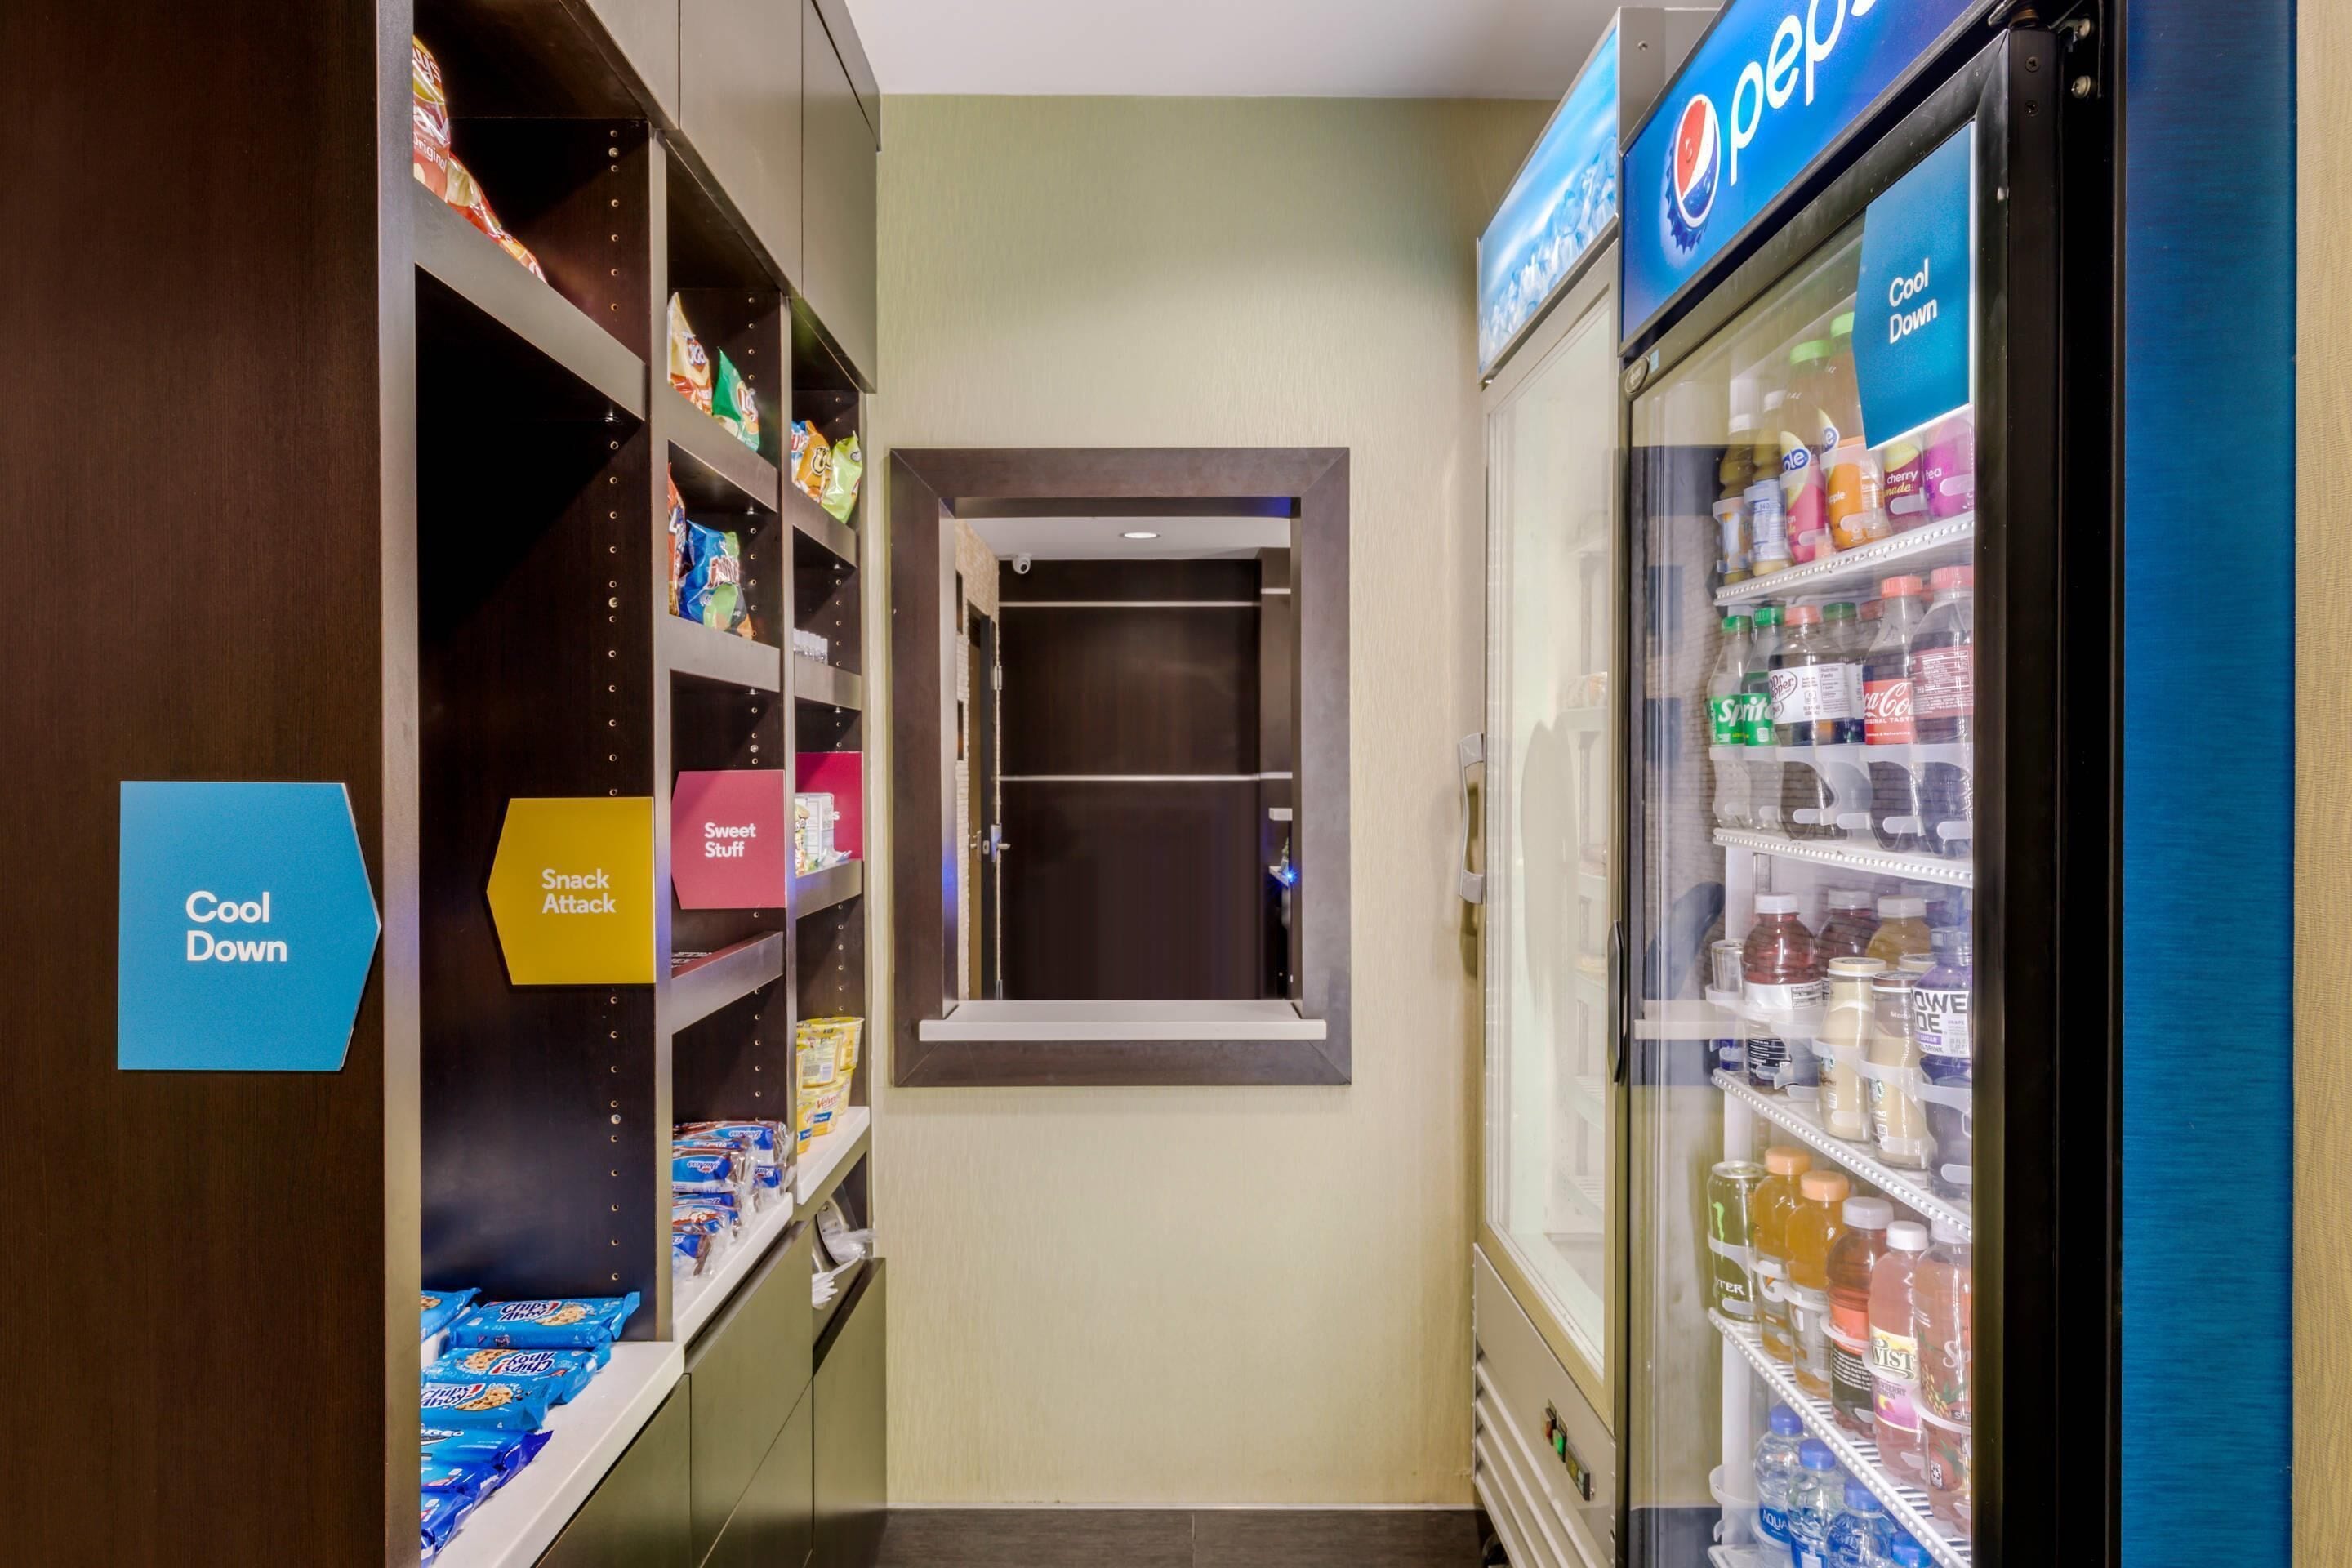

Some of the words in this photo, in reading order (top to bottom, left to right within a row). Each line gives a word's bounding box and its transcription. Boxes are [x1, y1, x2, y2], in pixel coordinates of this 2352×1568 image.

[1730, 0, 1876, 186] pep
[1889, 257, 1929, 307] Cool
[1889, 299, 1938, 344] Down
[1784, 449, 1805, 471] ole
[1886, 470, 1918, 484] cherry
[1925, 467, 1943, 481] tea
[1885, 482, 1912, 496] nade
[1770, 678, 1794, 700] epper
[704, 822, 756, 838] Sweet
[705, 841, 745, 858] Stuff
[541, 868, 610, 889] Snack
[185, 890, 270, 923] Cool
[541, 893, 617, 914] Attack
[187, 930, 287, 962] Down
[1913, 990, 1967, 1013] OWE
[1915, 1012, 1943, 1034] DE
[1920, 1034, 1938, 1043] SUGAR
[1717, 1279, 1745, 1296] TER
[501, 1301, 548, 1312] Chips
[503, 1361, 554, 1373] Chips
[1871, 1345, 1916, 1372] WIST
[1762, 1508, 1788, 1530] AQUA
